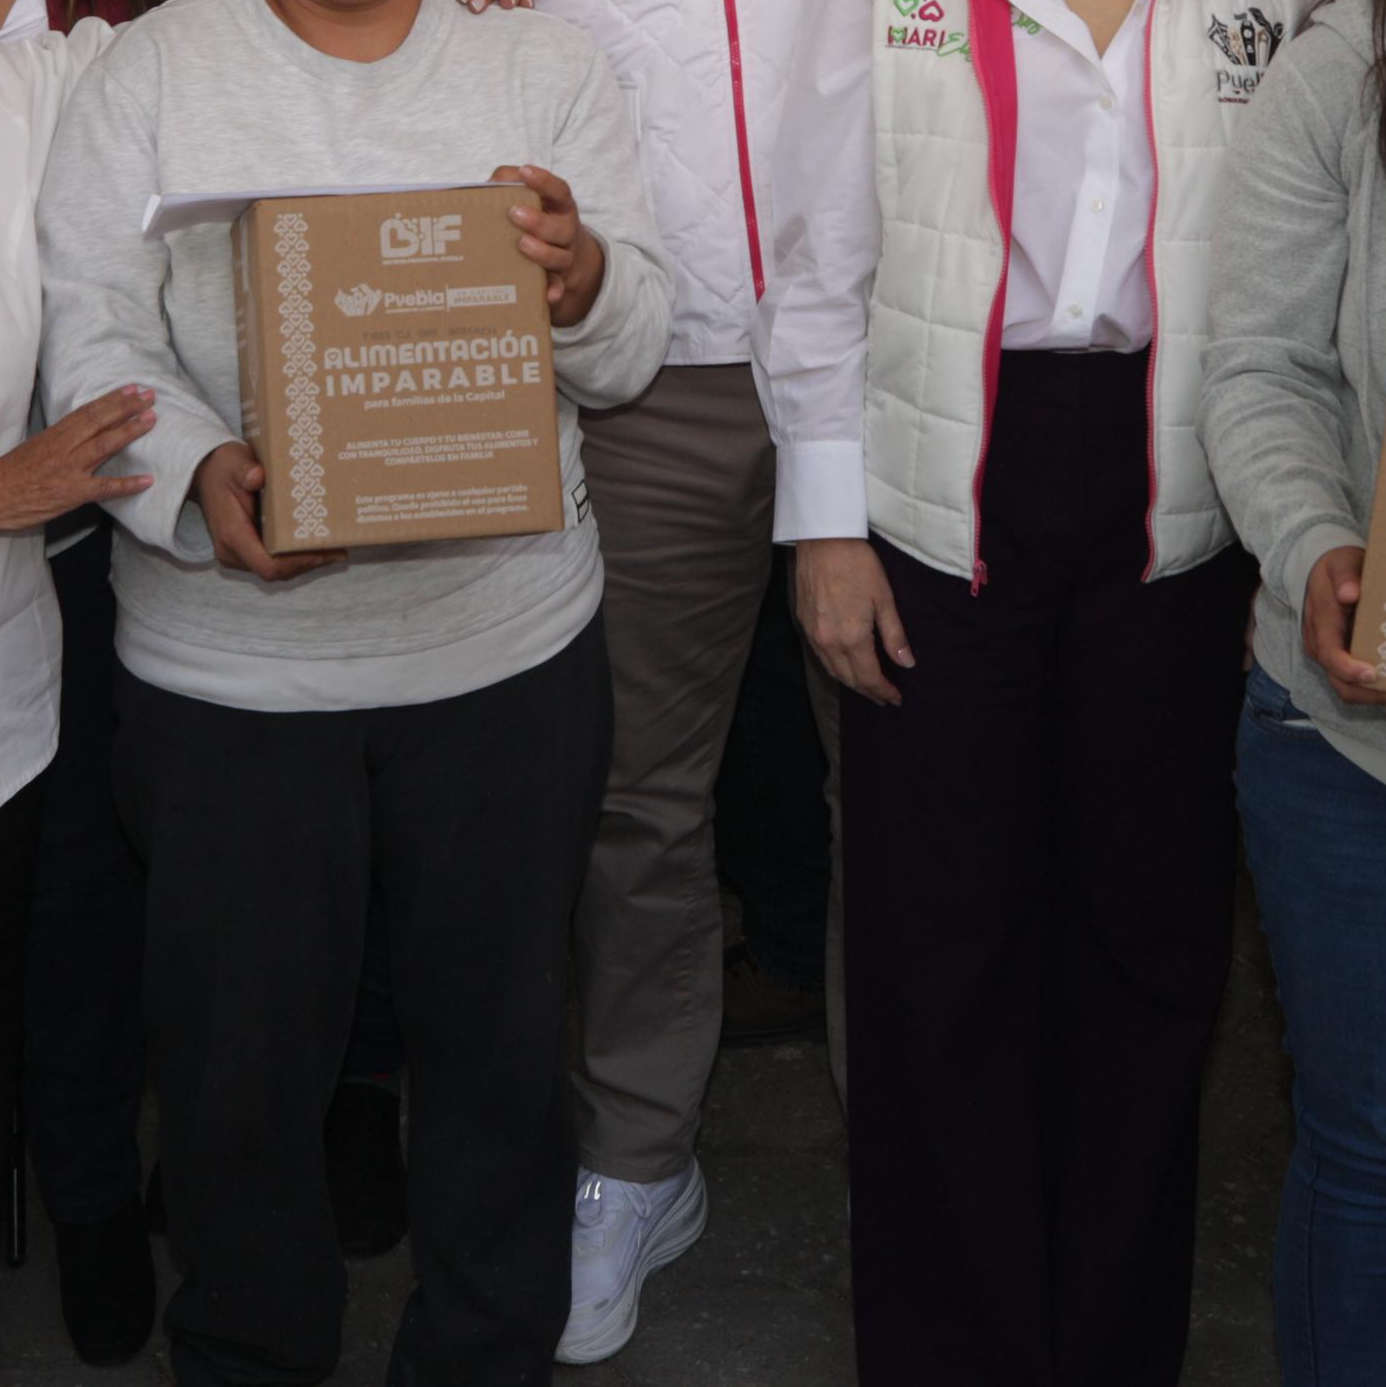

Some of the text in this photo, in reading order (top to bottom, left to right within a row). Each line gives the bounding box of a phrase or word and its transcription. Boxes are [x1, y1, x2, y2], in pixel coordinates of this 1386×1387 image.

[887, 25, 945, 48] MARI
[1217, 70, 1260, 93] Pue
[379, 213, 462, 258] DIF
[384, 289, 445, 307] Puebla
[324, 330, 539, 370] ALIMENTACIÓN
[325, 361, 542, 397] IMPARABLE
[364, 389, 505, 410] para familias de la Capital
